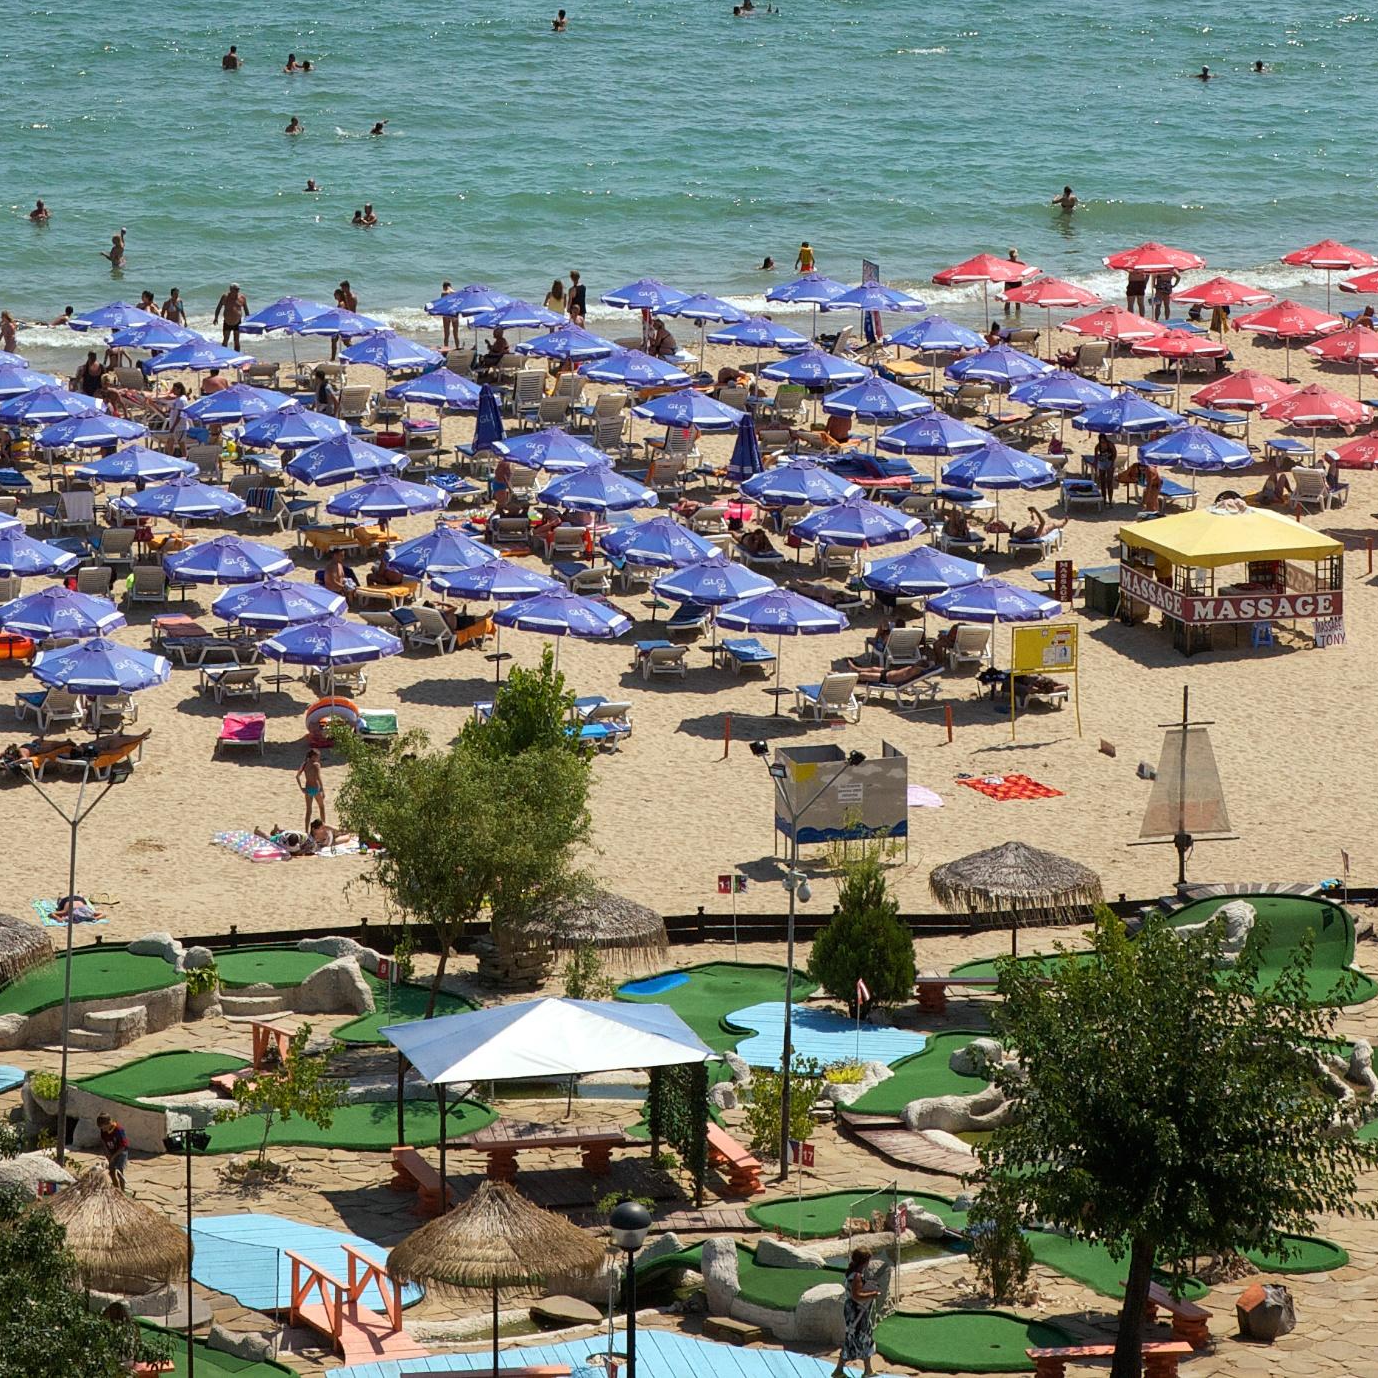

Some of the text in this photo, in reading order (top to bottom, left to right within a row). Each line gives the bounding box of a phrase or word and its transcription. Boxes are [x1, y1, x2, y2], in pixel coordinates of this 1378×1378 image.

[1059, 561, 1069, 602] MASSAGE
[1122, 567, 1183, 616] MASSAGE
[1193, 594, 1333, 621] MASSAGE
[1315, 617, 1343, 633] MASSAGE
[1321, 632, 1346, 648] TONY
[380, 963, 387, 974] 9
[803, 1149, 814, 1162] 17
